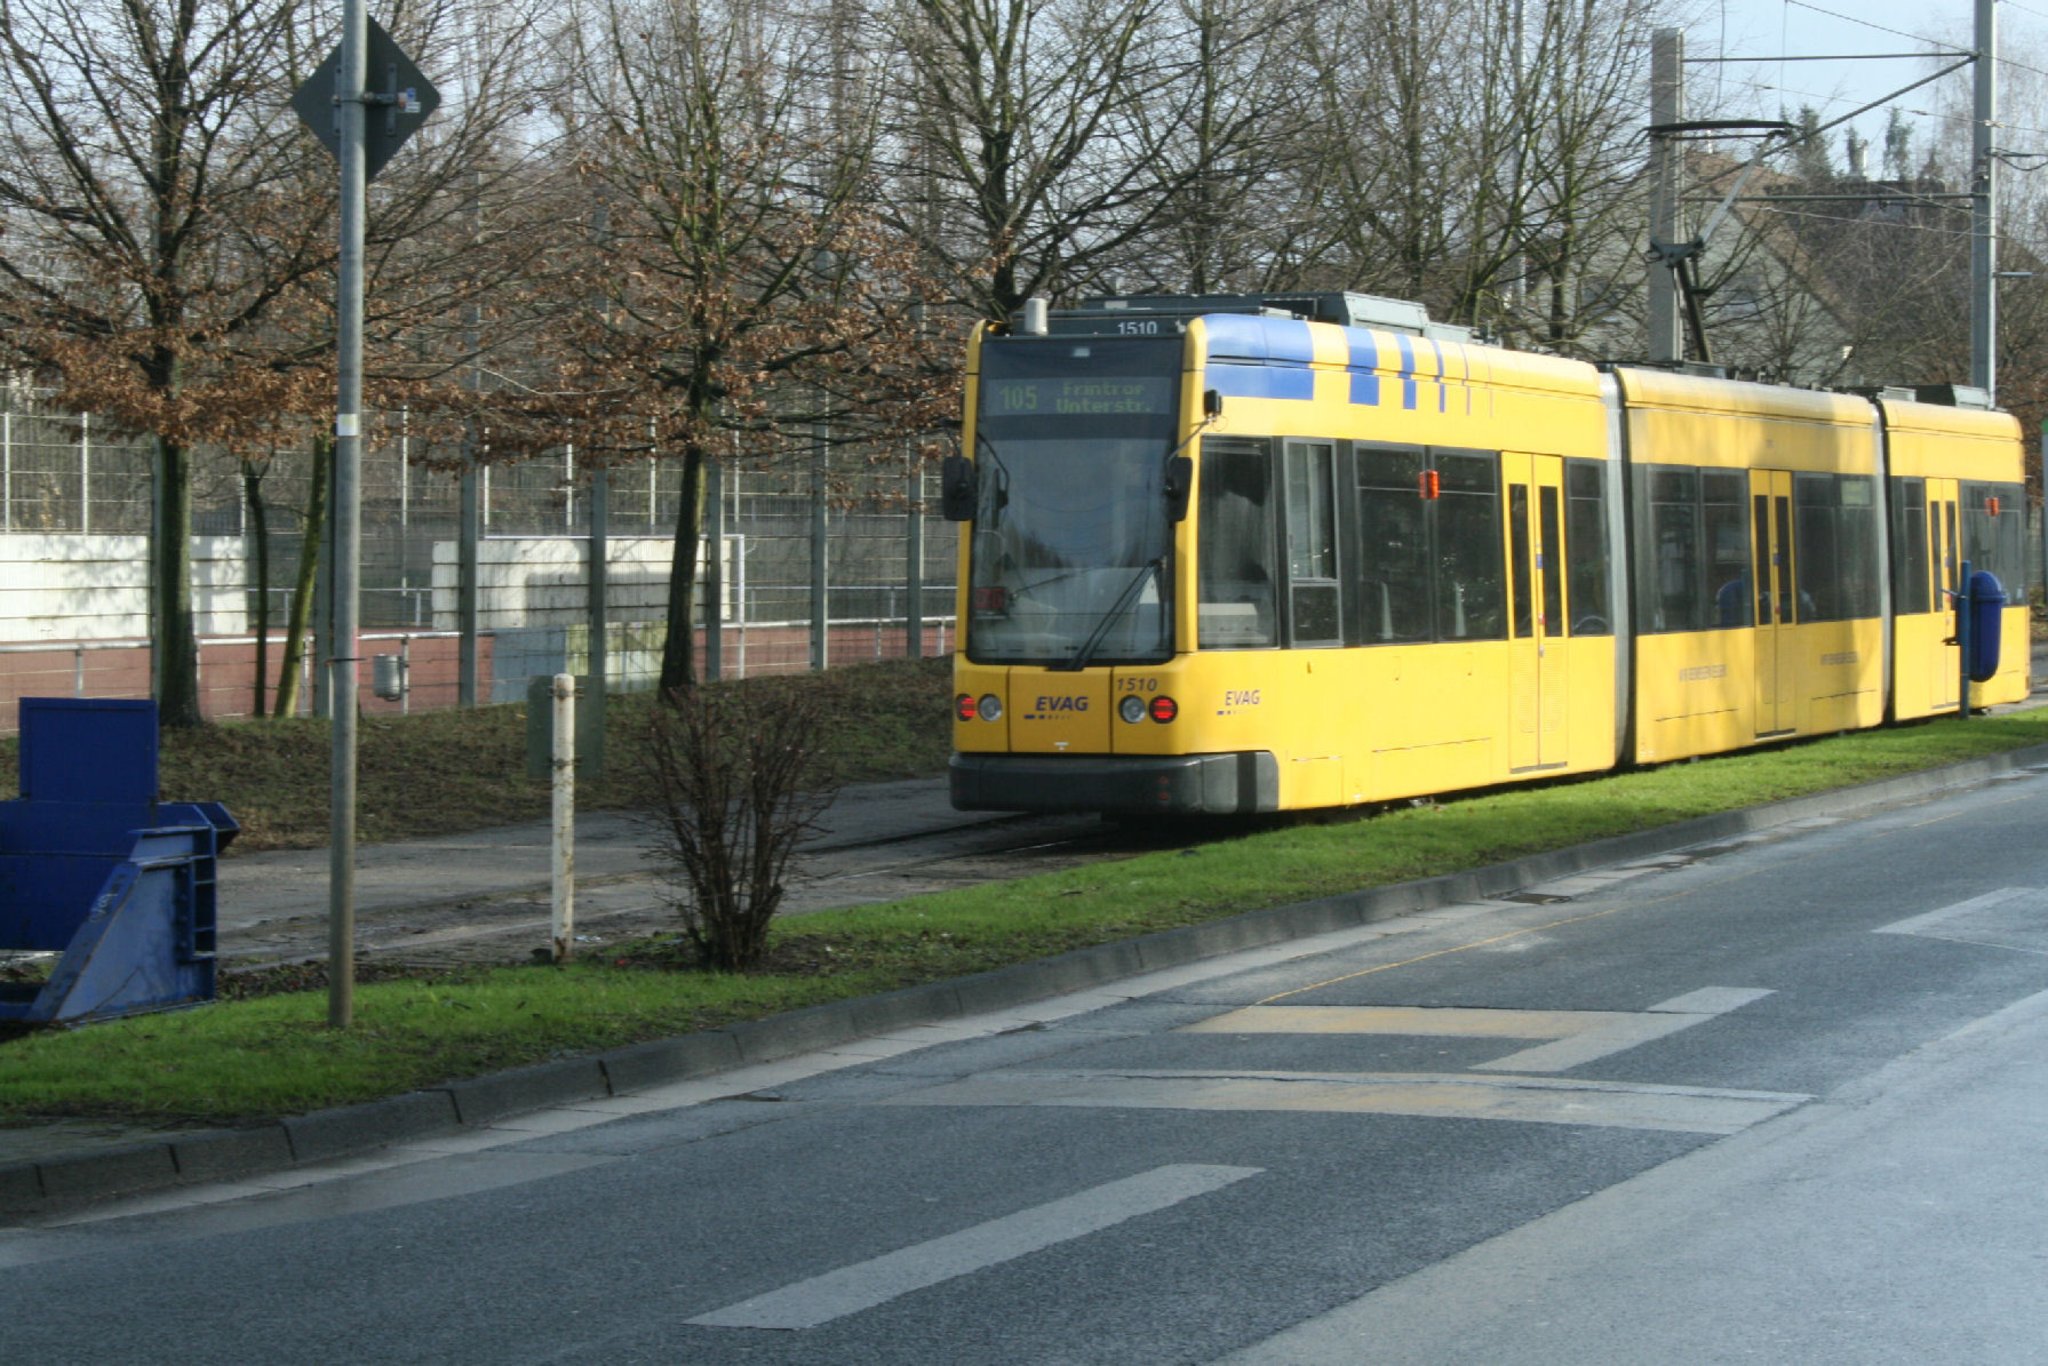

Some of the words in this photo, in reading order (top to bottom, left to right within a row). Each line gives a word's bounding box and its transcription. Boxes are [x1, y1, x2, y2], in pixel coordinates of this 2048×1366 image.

[1118, 321, 1158, 335] 1510
[999, 385, 1038, 411] 105
[1056, 398, 1153, 414] Unterstr.
[1117, 677, 1158, 692] 1510
[1035, 696, 1089, 712] EVAG
[1225, 689, 1261, 706] EVAG
